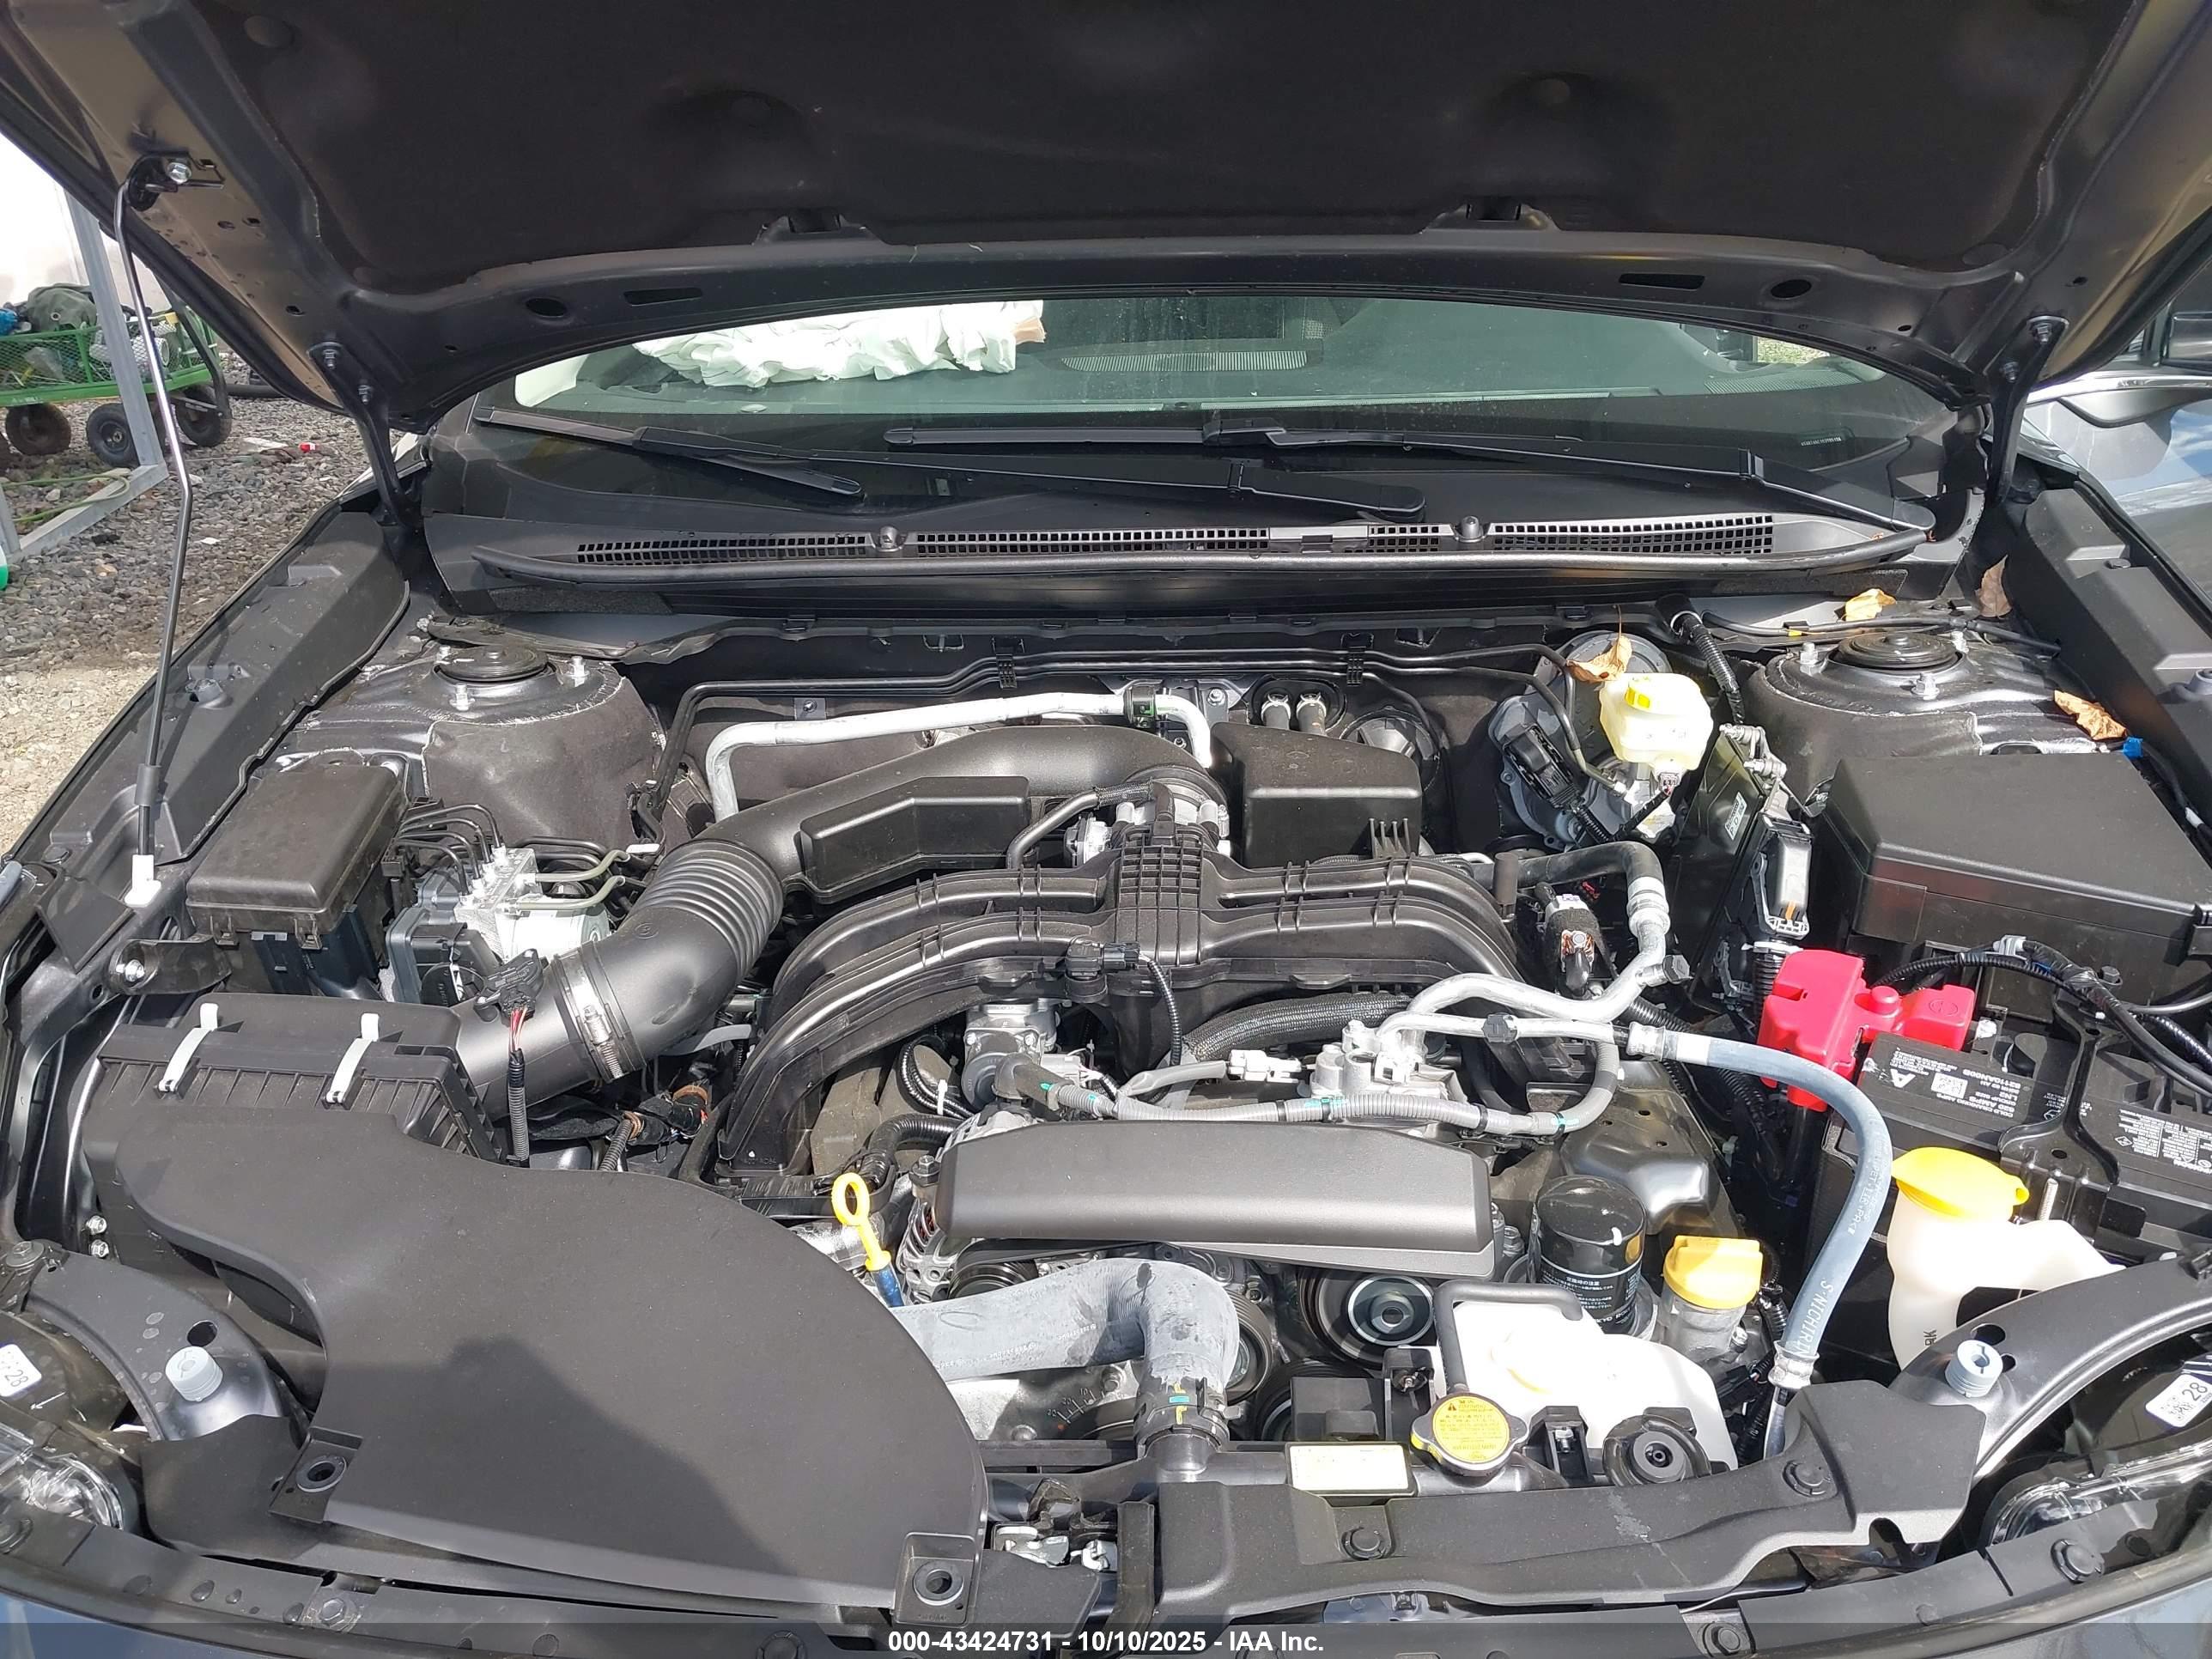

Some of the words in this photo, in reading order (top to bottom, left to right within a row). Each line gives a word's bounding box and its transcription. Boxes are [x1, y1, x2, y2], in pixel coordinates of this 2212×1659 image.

[1968, 1096, 1997, 1108] AMPS
[1998, 1091, 2018, 1101] LN2
[4, 1369, 29, 1387] 28
[2181, 1382, 2209, 1401] 28
